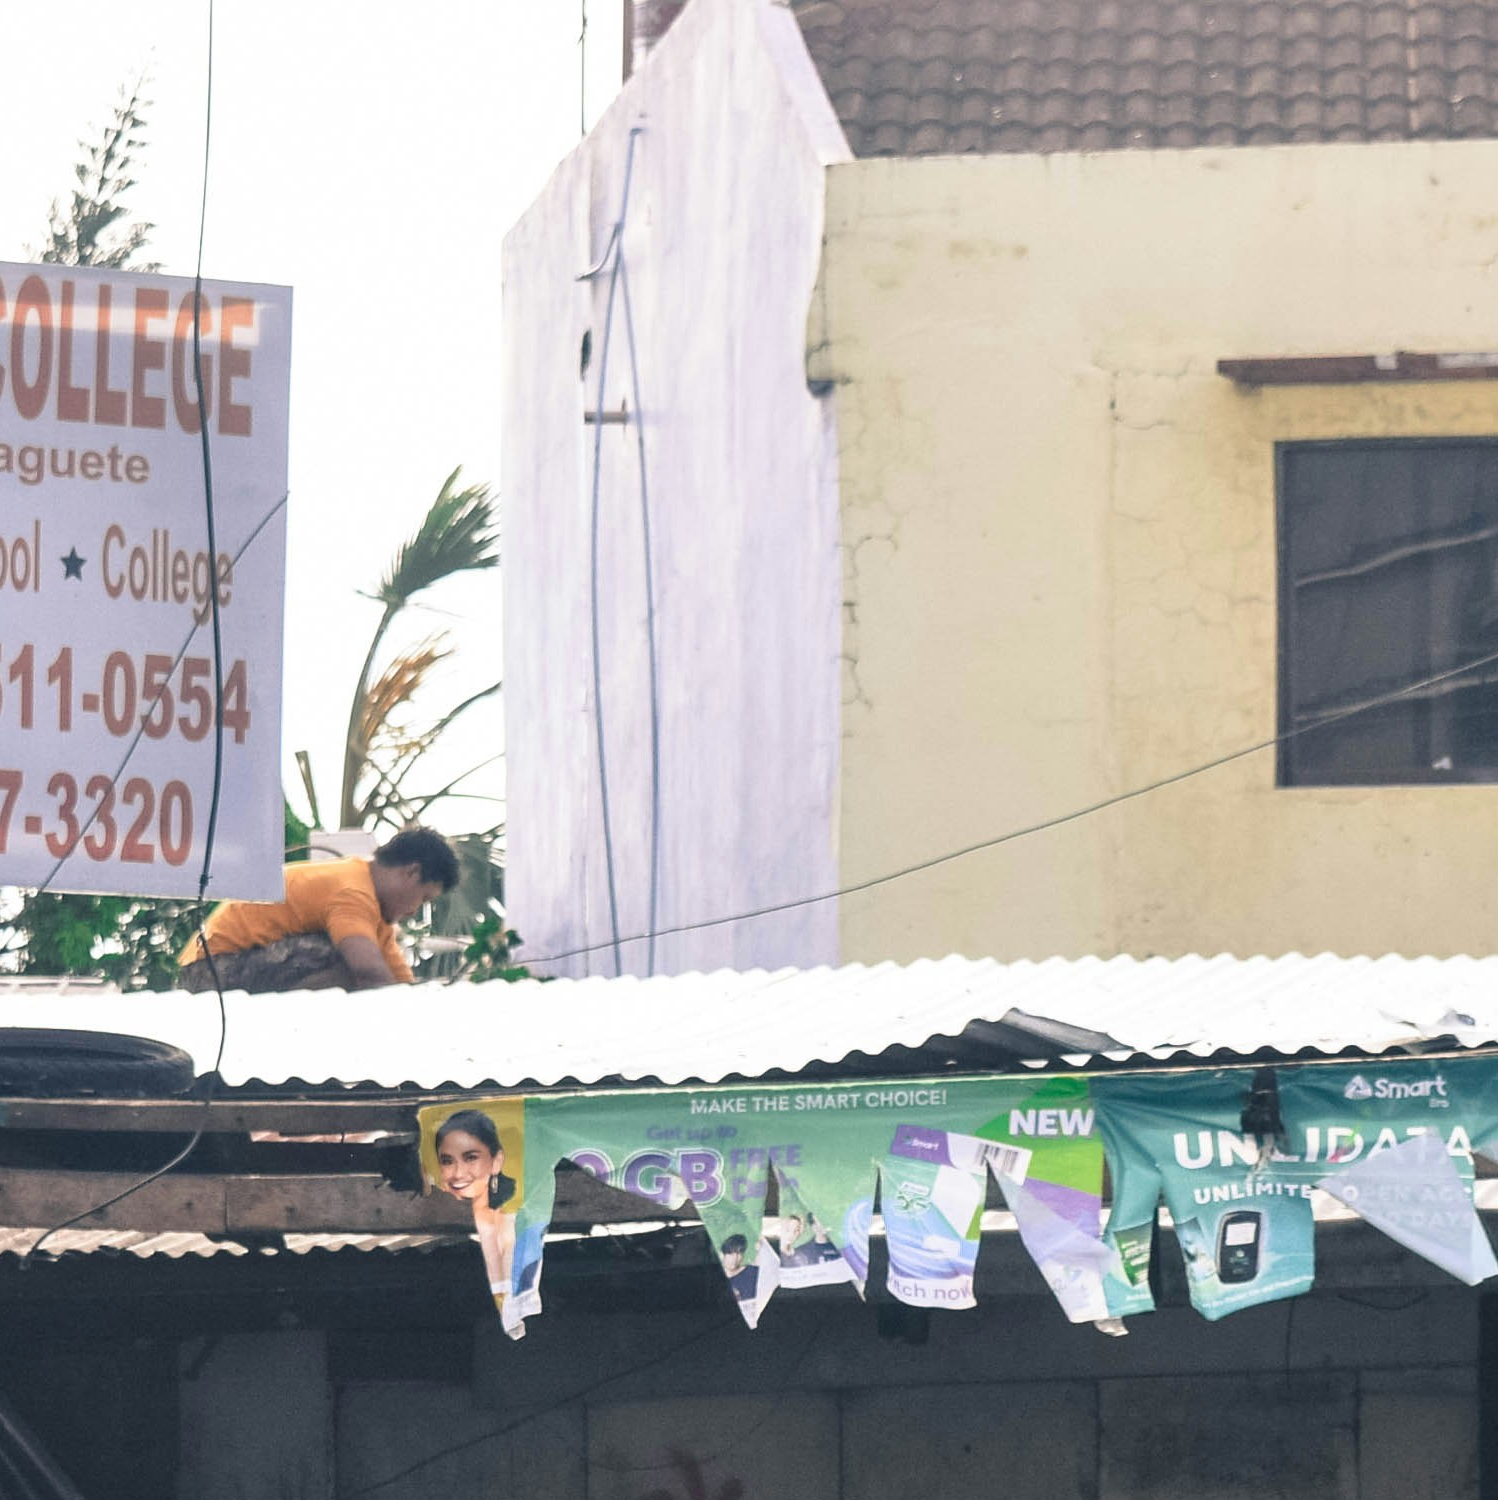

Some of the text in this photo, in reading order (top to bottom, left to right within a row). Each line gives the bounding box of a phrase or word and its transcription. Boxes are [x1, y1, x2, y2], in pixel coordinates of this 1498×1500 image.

[103, 523, 235, 627] College
[1373, 1074, 1449, 1100] Smart
[690, 1089, 948, 1115] MAKE THE SMART CHOICE!
[646, 1124, 683, 1141] Get
[687, 1127, 710, 1141] up
[1008, 1107, 1096, 1137] NEW
[729, 1143, 804, 1171] FREE
